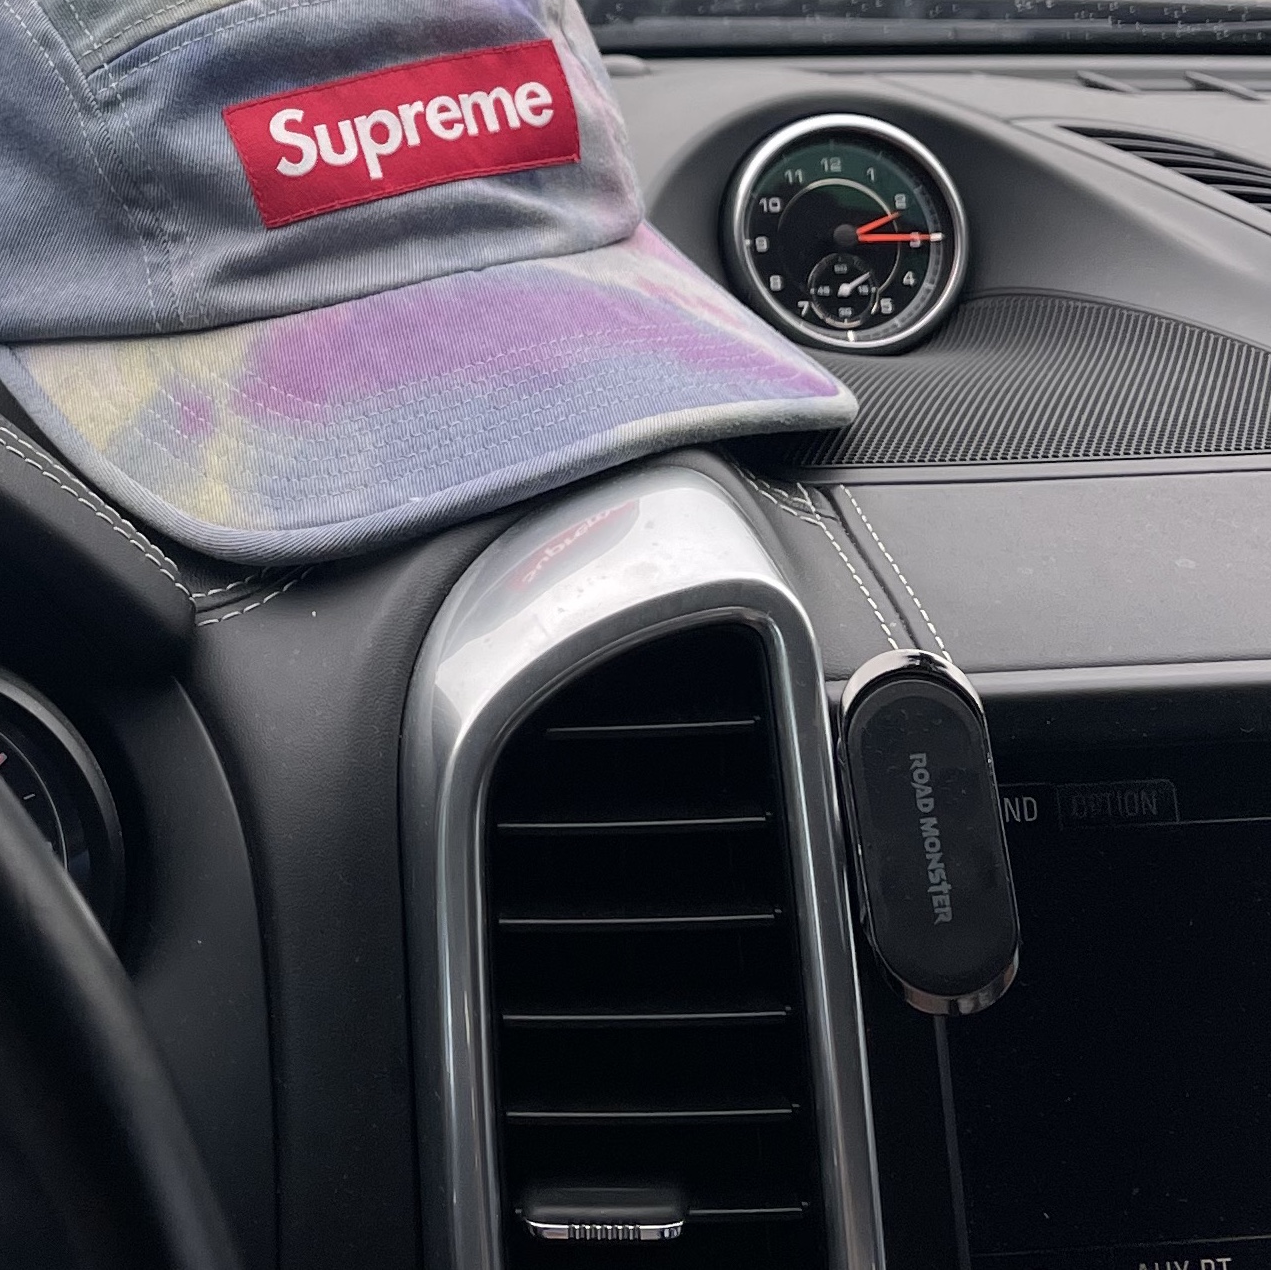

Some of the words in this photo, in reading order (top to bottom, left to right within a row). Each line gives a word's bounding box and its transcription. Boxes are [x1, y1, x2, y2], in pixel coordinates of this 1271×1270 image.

[269, 81, 554, 180] Supreme
[821, 157, 842, 172] 12
[785, 168, 804, 183] 11
[866, 167, 875, 181] 1
[759, 197, 781, 213] 10
[903, 271, 916, 286] 4
[797, 300, 809, 316] 7
[880, 298, 893, 314] 5
[909, 752, 935, 814] ROAD
[1004, 796, 1038, 823] ND
